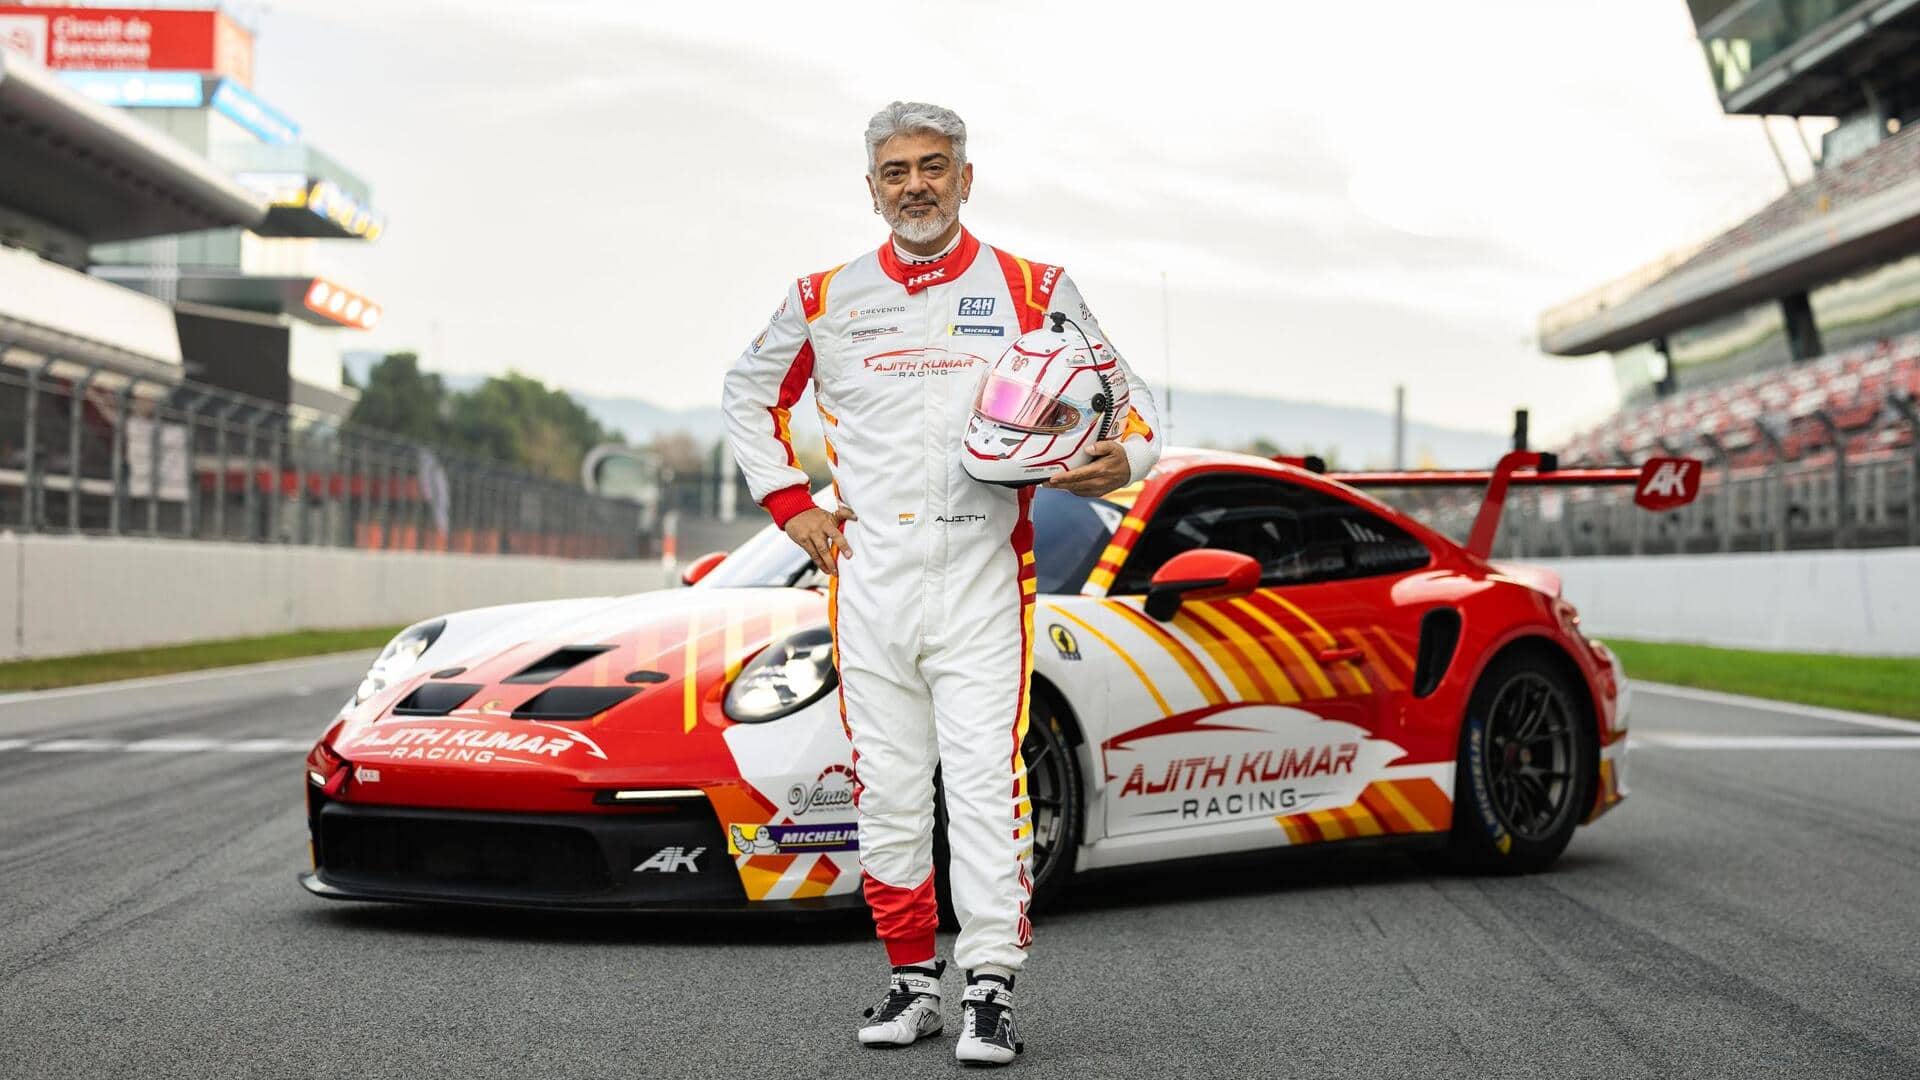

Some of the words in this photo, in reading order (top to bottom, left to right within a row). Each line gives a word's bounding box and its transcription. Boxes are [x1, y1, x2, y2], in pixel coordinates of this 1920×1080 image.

[908, 268, 945, 286] HRX
[961, 298, 994, 310] 24H
[851, 326, 899, 337] PORSCHE
[874, 360, 917, 372] AJITH
[920, 359, 974, 370] KUMAR
[898, 369, 948, 378] RACING
[1642, 462, 1690, 496] AK
[935, 513, 986, 523] AJITH
[355, 727, 448, 748] AJITH
[444, 728, 575, 757] KUMAR
[390, 747, 496, 764] RACING
[1120, 754, 1232, 798] AJITH
[1236, 742, 1359, 786] KUMAR
[1182, 788, 1297, 820] RACING
[780, 829, 859, 844] MICHELIN
[632, 846, 707, 873] AK
